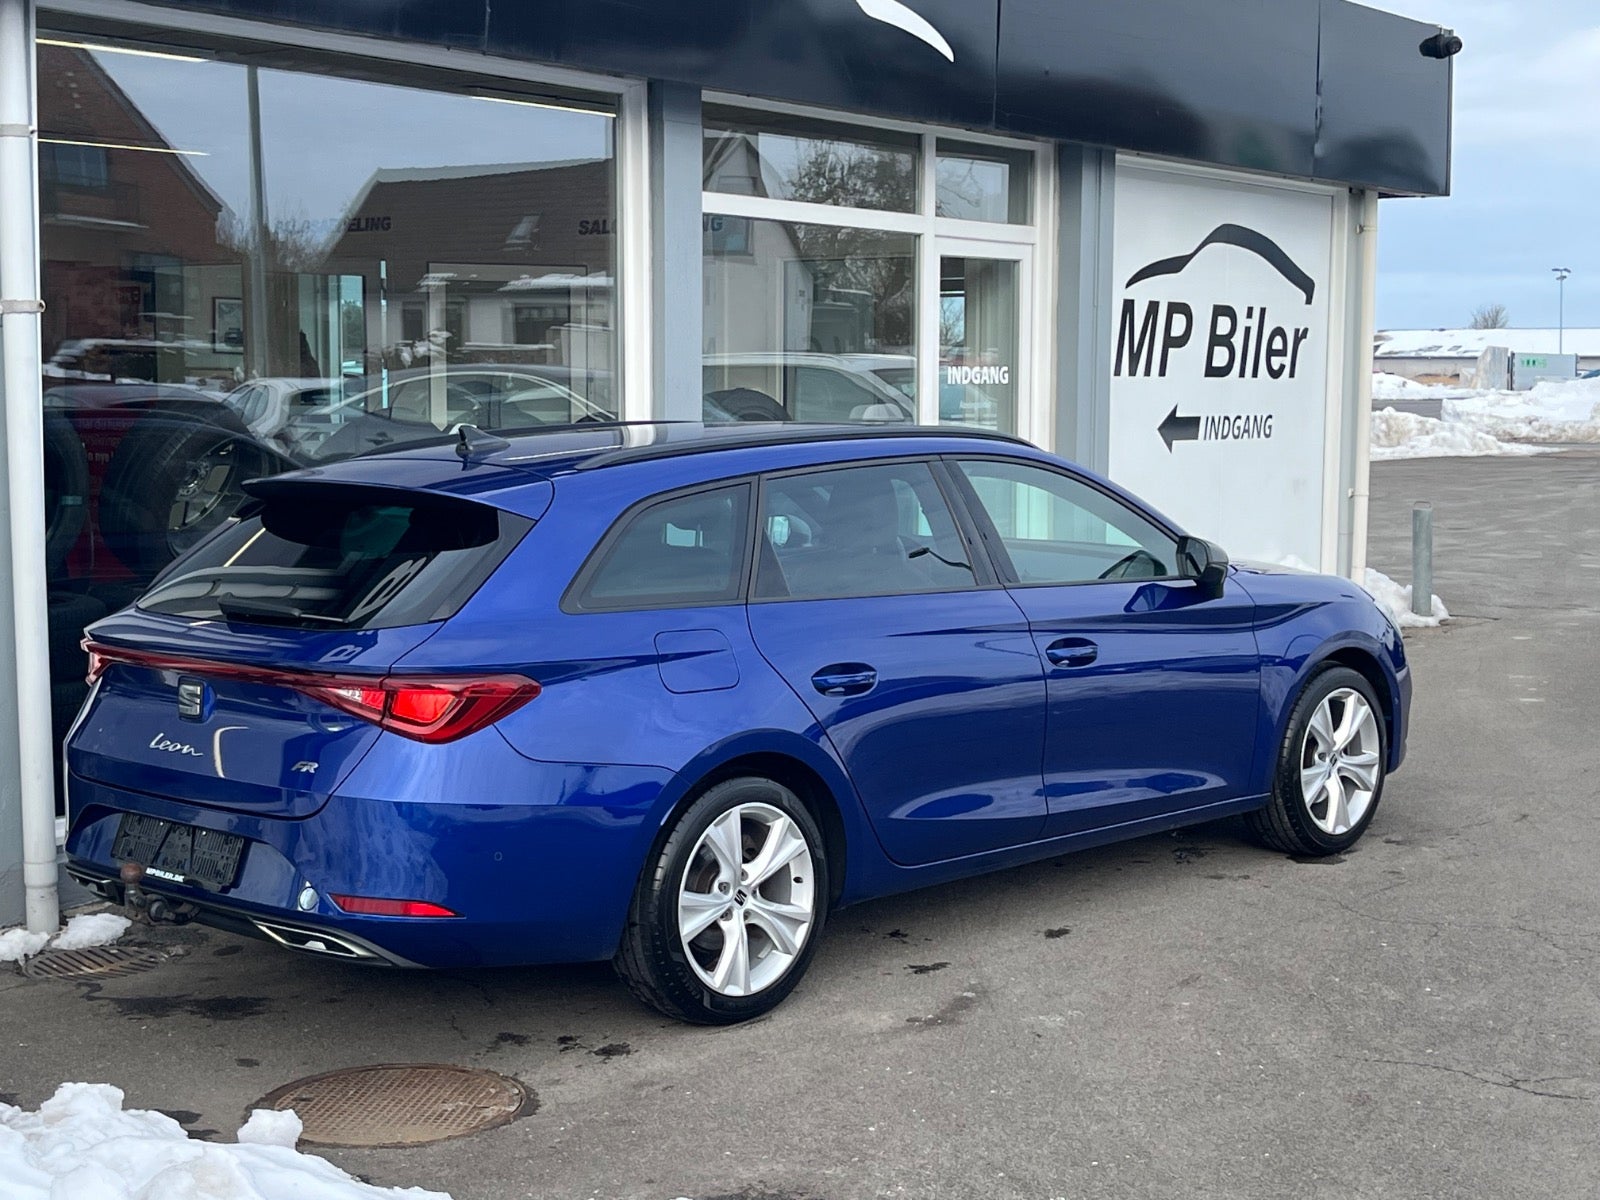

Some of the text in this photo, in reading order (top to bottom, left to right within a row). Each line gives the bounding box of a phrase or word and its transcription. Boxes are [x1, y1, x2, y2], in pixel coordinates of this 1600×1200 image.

[1113, 298, 1309, 379] MP Biler
[947, 366, 1009, 385] INDGANG
[1203, 414, 1273, 441] INDGANG
[149, 732, 204, 756] Leon
[291, 761, 318, 773] FR
